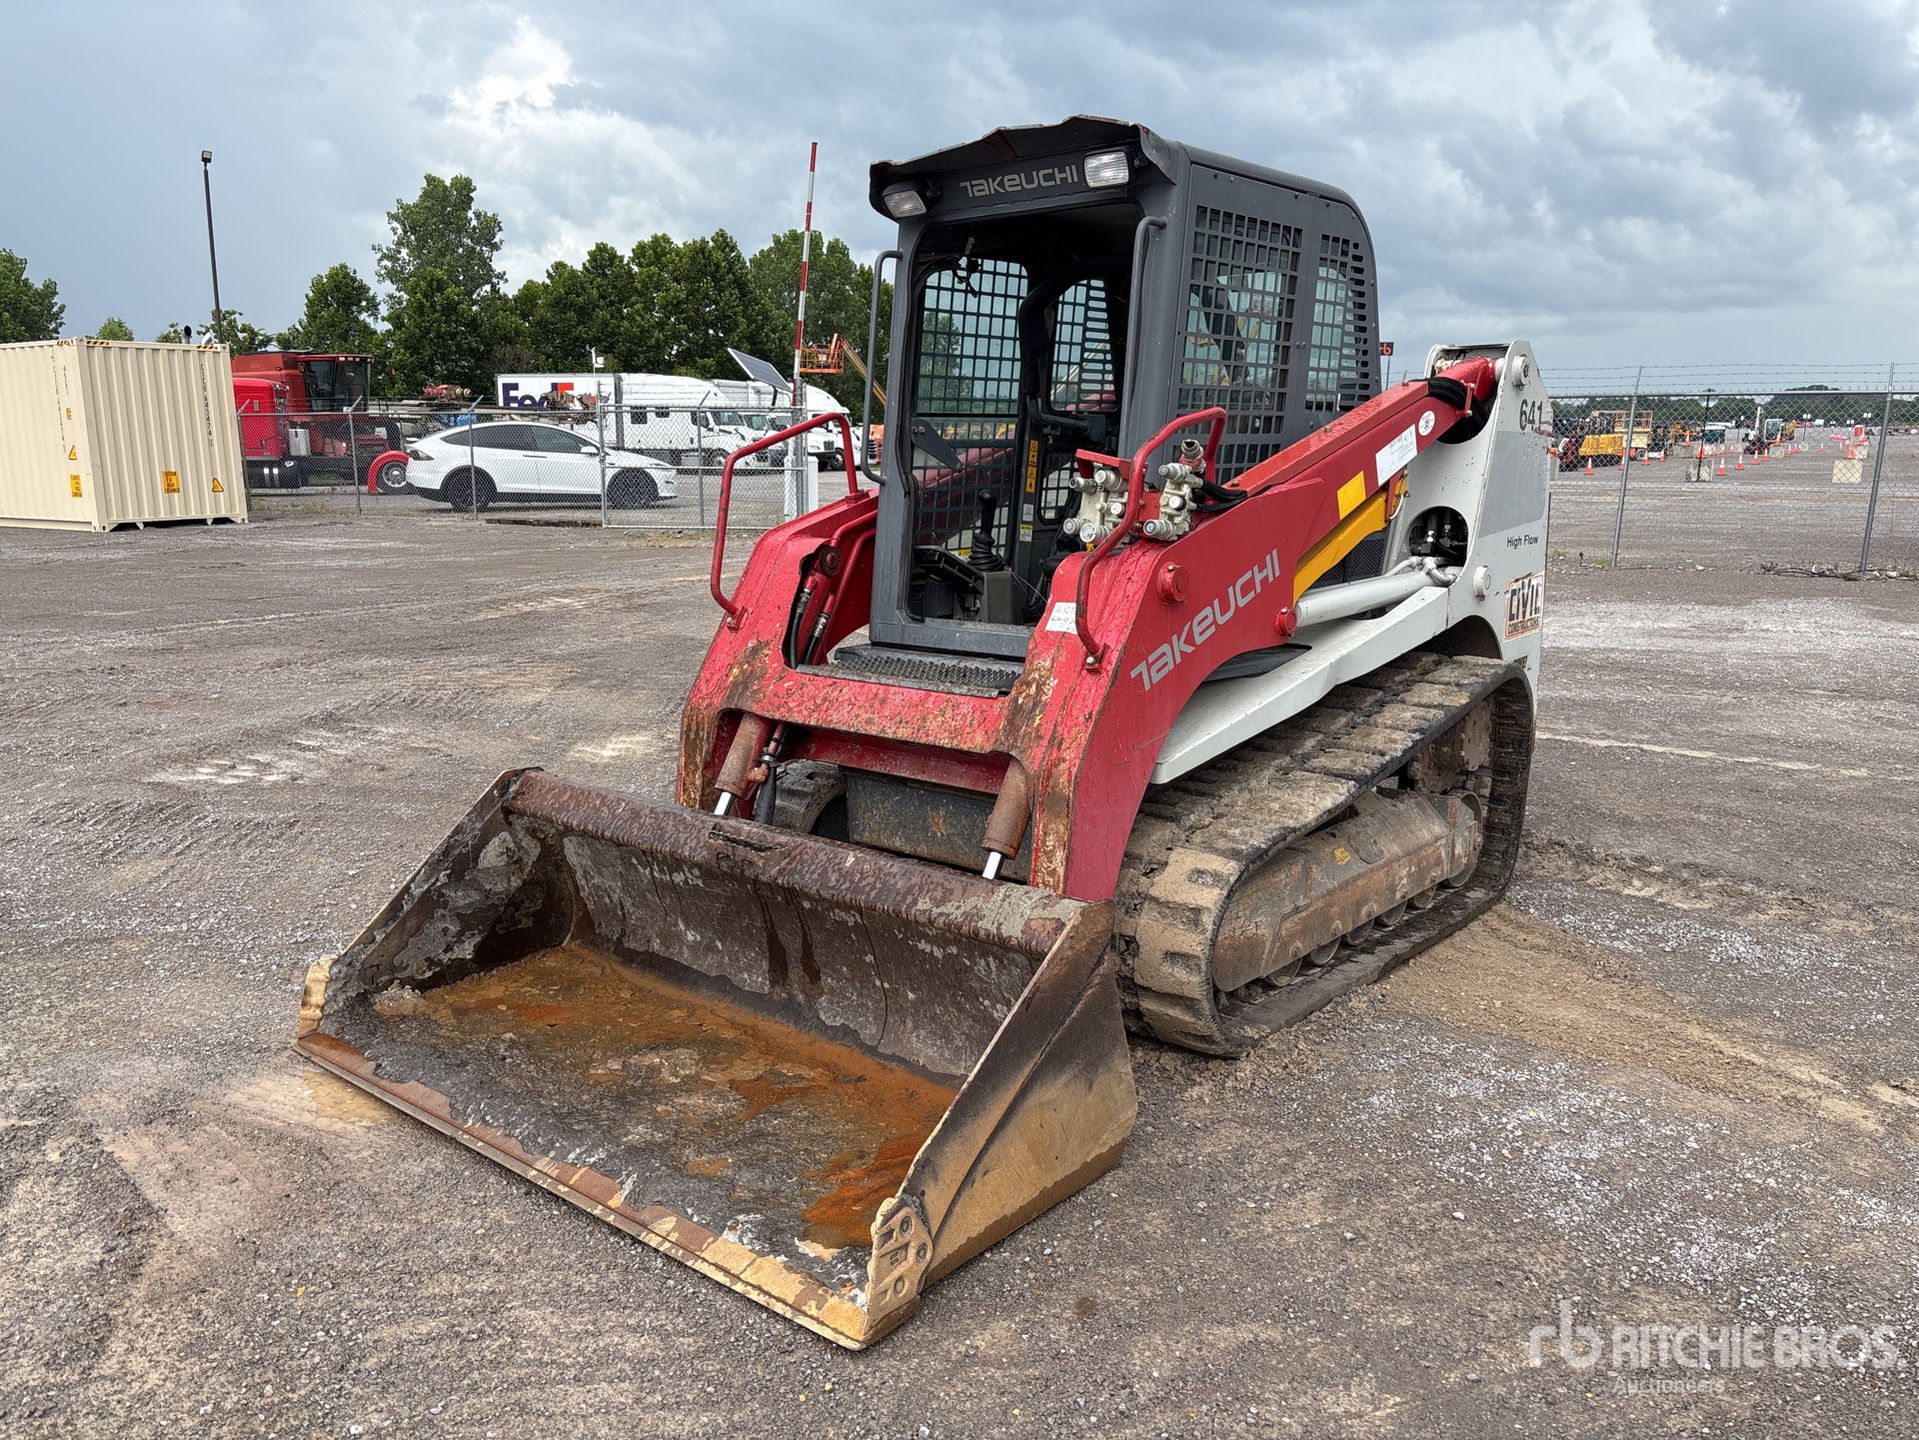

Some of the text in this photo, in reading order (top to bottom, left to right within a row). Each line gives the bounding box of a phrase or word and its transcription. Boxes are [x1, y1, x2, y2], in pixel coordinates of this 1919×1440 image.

[959, 165, 1079, 198] TAKEUCHI
[1519, 398, 1543, 432] 641
[1506, 533, 1539, 550] High Flow
[1130, 548, 1280, 692] TAKEUCHI
